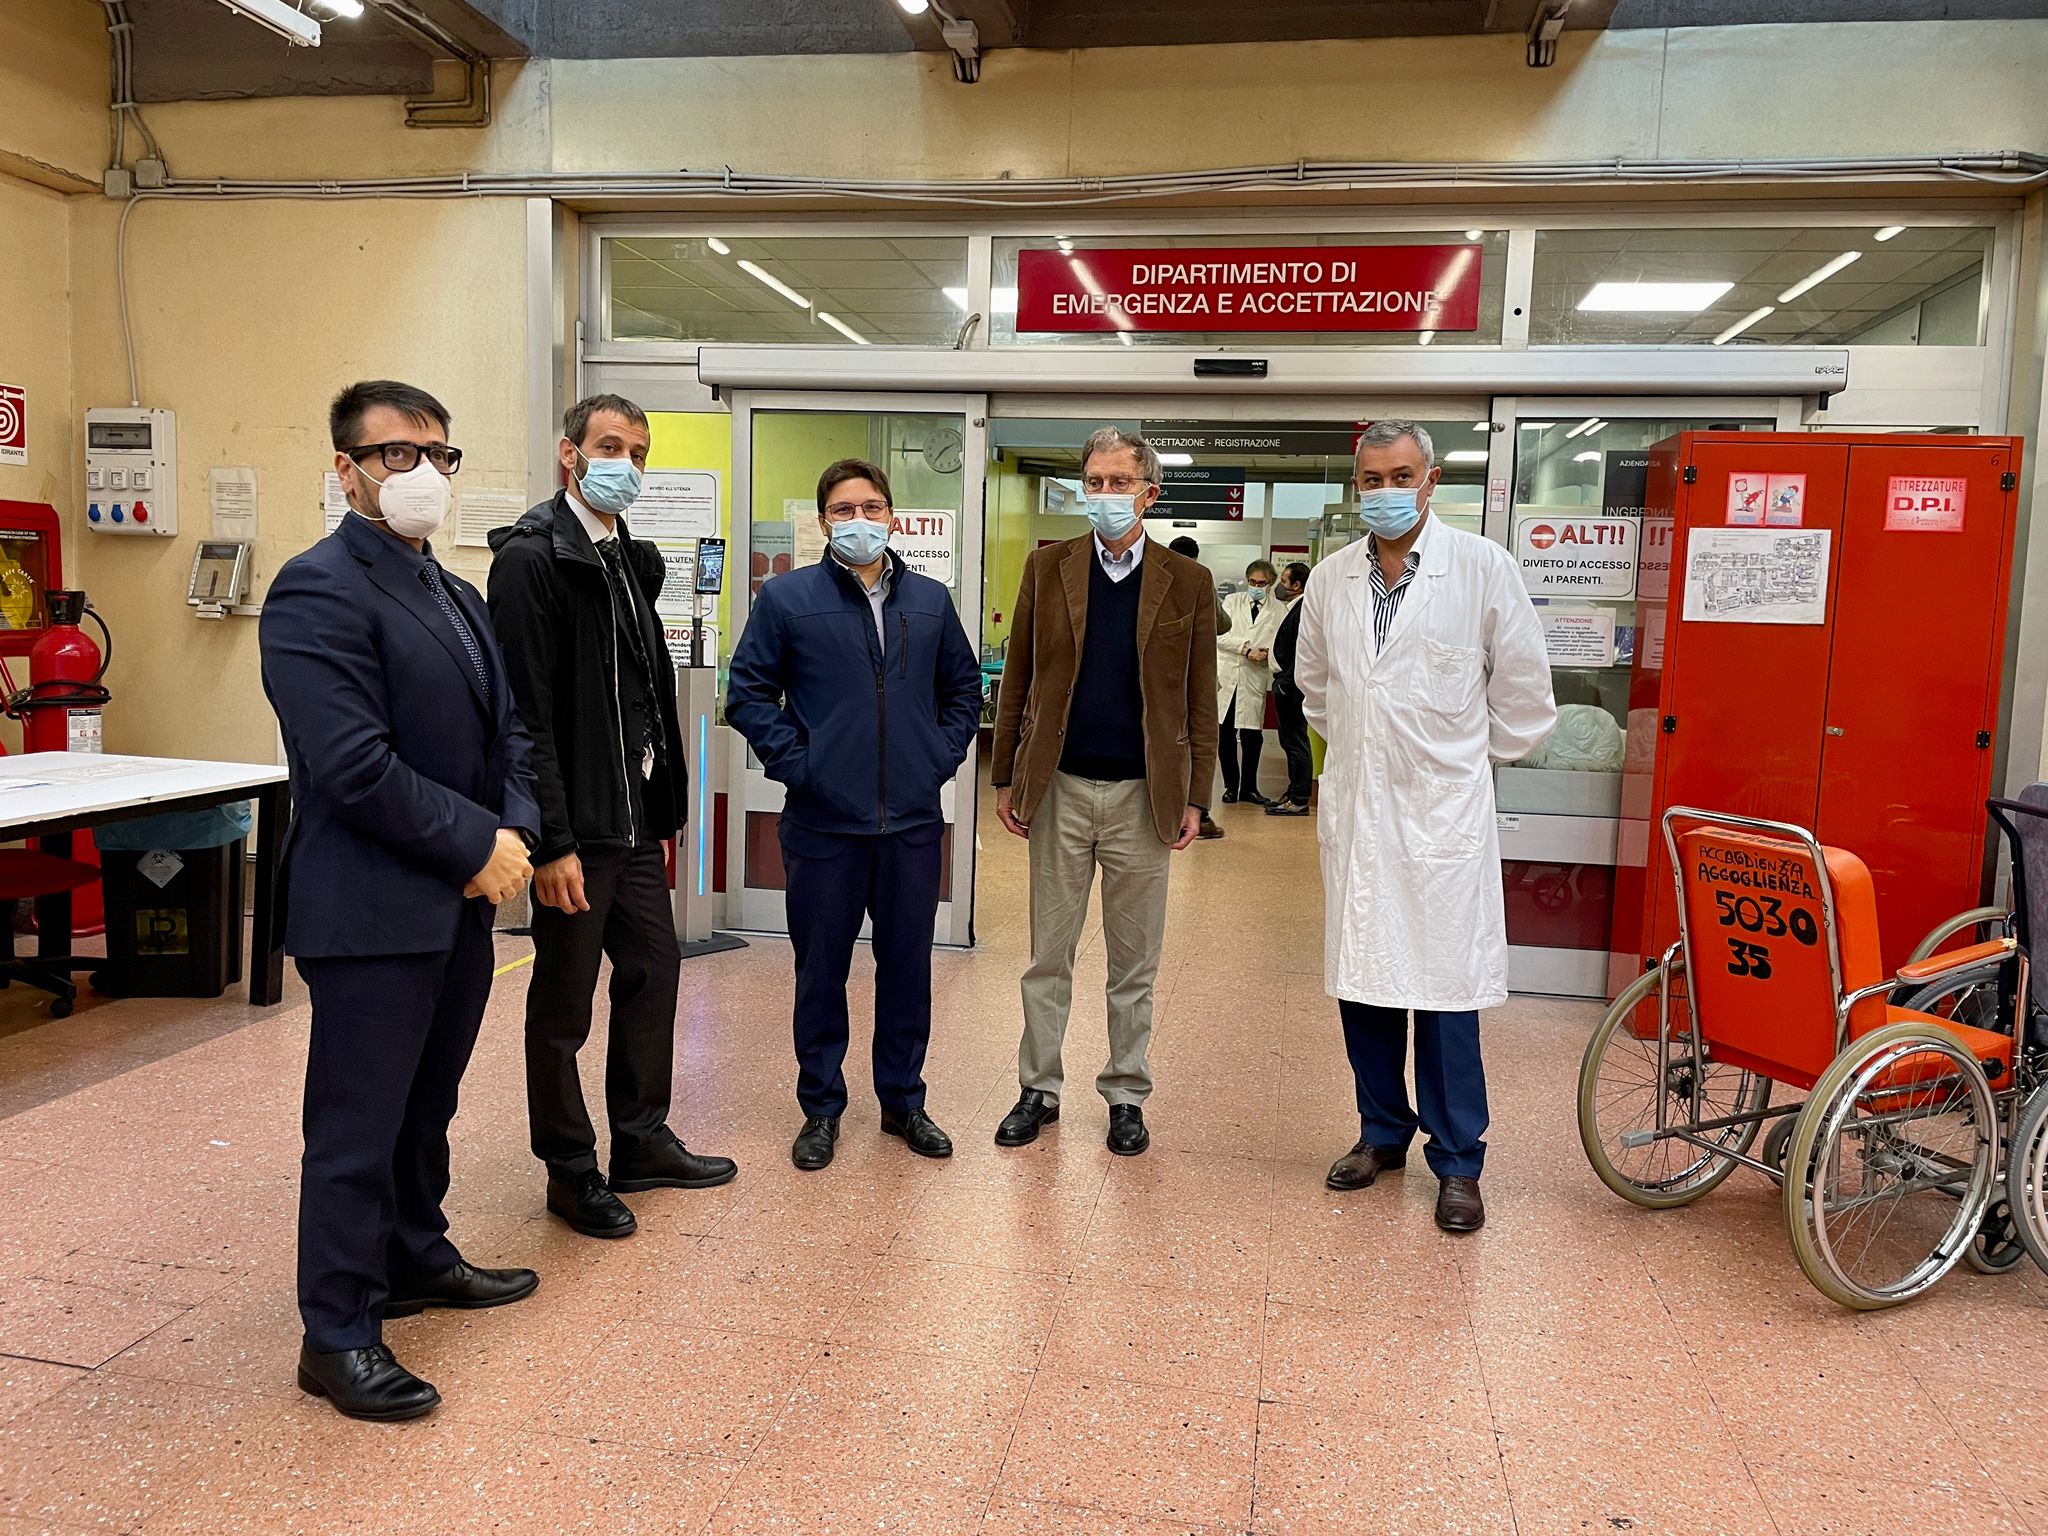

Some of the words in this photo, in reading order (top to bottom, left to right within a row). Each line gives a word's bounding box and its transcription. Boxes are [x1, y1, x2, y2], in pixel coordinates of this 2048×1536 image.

[1132, 263, 1323, 285] DIPARTIMENTO
[1331, 262, 1357, 283] DI
[1053, 293, 1210, 315] EMERGENZA
[1217, 293, 1233, 314] E
[1239, 291, 1440, 314] ACCETTAZIONE
[1214, 439, 1281, 448] REGISTRAZIONE
[1173, 471, 1210, 479] SOCCORSO
[1891, 480, 1964, 492] ATTREZZATURE
[1893, 497, 1956, 512] D.P.I.
[890, 517, 943, 535] ALT!!
[1559, 524, 1625, 544] ALT!!
[906, 550, 950, 558] ACCESSO
[1522, 559, 1564, 568] DIVIETO
[1566, 560, 1577, 568] DI
[1579, 560, 1631, 569] ACCESSO
[1543, 575, 1553, 583] AI
[1556, 575, 1603, 584] PARENTI.
[1715, 890, 1819, 945] 5030
[1727, 937, 1772, 979] 35
